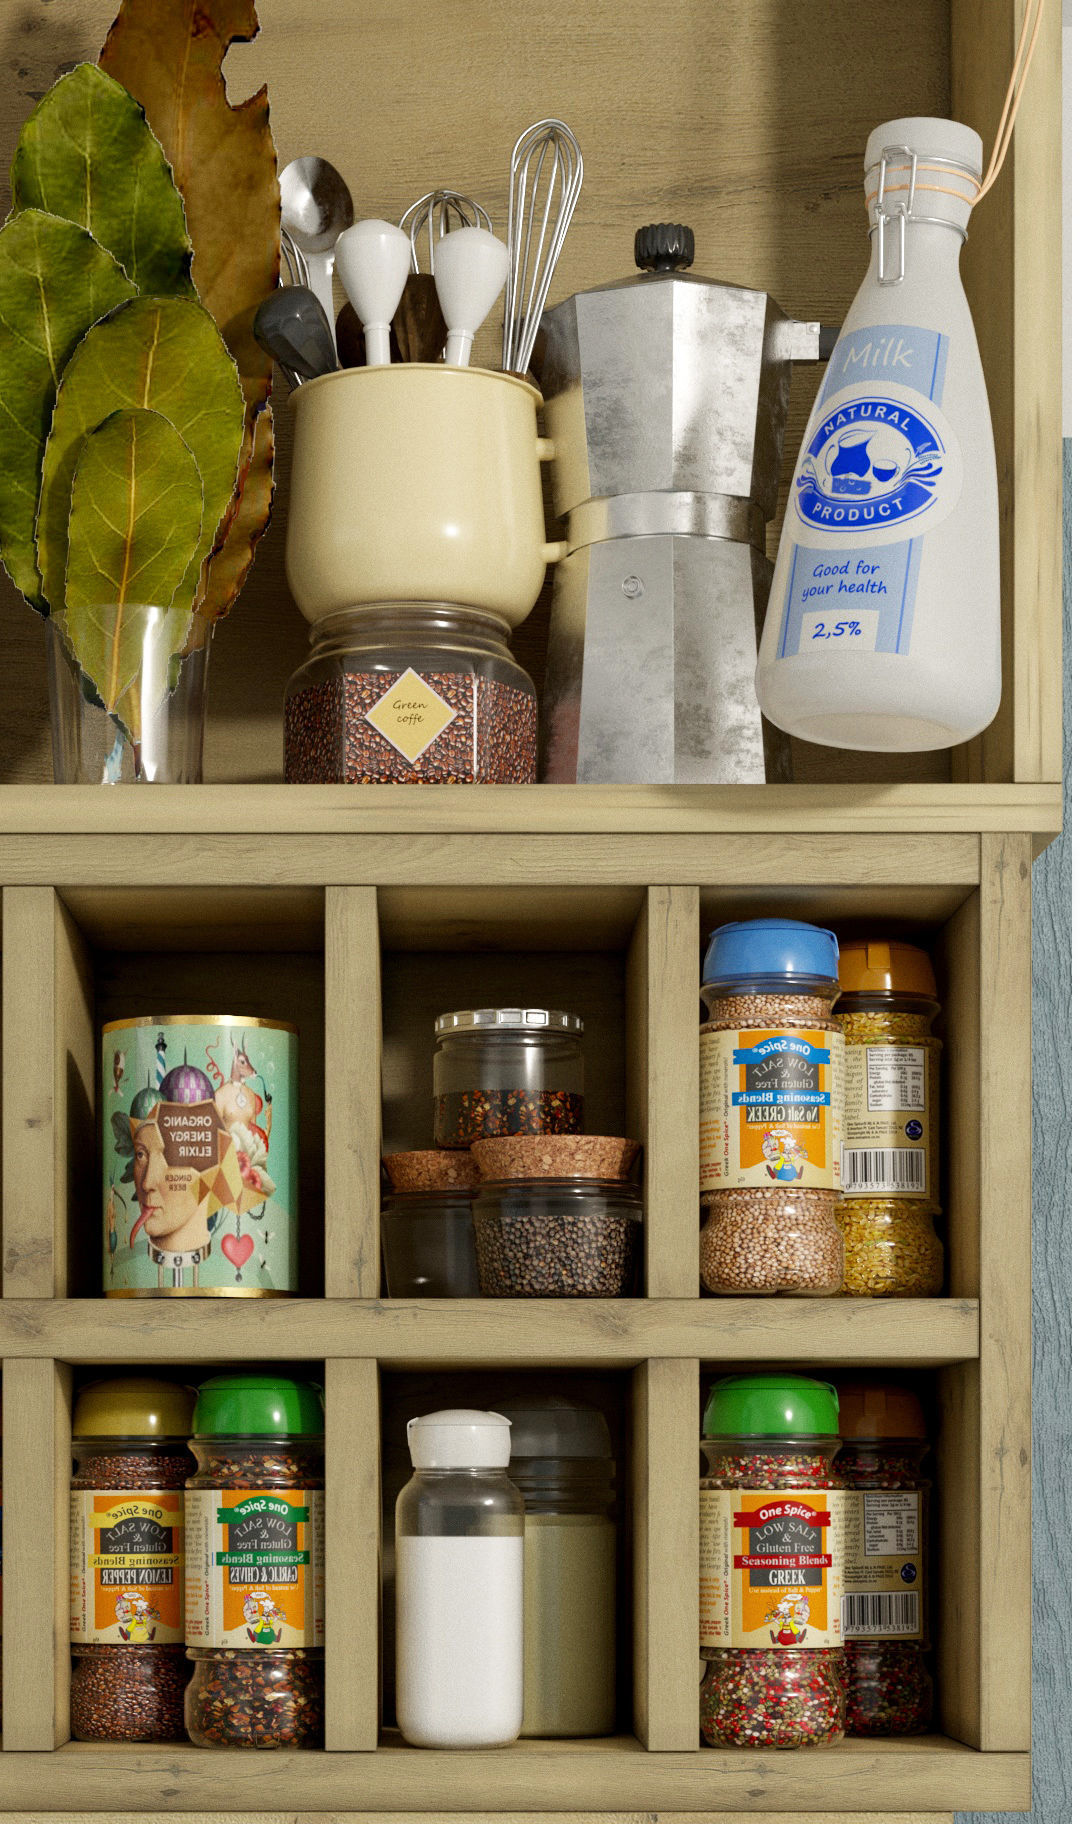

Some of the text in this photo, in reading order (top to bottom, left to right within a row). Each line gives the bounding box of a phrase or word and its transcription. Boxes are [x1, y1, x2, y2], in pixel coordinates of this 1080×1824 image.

[843, 336, 915, 373] Milk
[823, 405, 912, 436] NATURAL
[811, 498, 905, 523] PRODUCT
[813, 560, 880, 578] Good for
[802, 579, 888, 602] your health
[812, 621, 862, 639] 2,5%
[392, 699, 428, 710] Green
[396, 713, 424, 726] coffe
[759, 1507, 783, 1520] One
[756, 1522, 817, 1541] LOW SALT
[782, 1533, 792, 1543] &
[756, 1543, 815, 1553] Gluten Free
[742, 1555, 828, 1567] Seasoning Blends
[769, 1570, 806, 1585] GREEK
